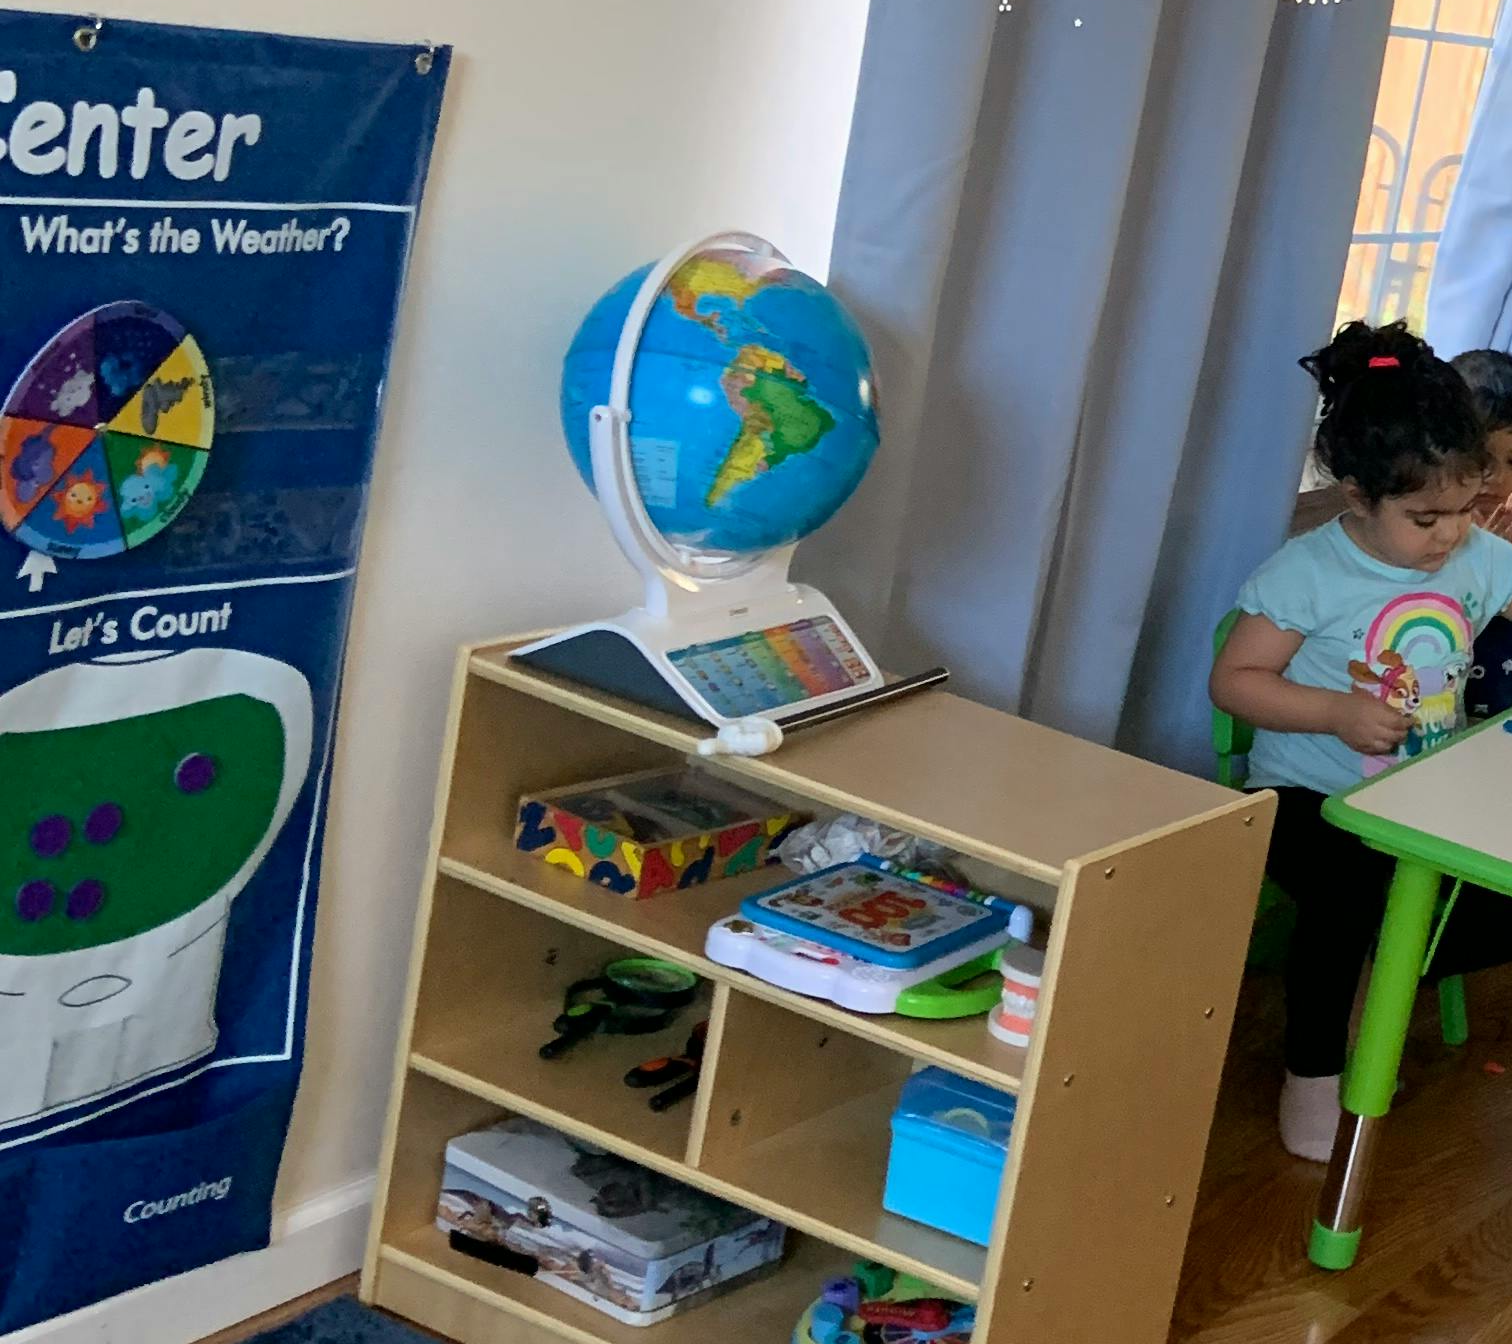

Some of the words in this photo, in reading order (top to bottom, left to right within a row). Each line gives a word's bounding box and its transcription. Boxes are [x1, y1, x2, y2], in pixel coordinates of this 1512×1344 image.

[20, 214, 141, 255] What's
[149, 216, 201, 254] the
[211, 216, 351, 255] Weather?
[47, 612, 119, 656] Let's
[130, 601, 233, 641] Count
[122, 1175, 234, 1224] Counting
